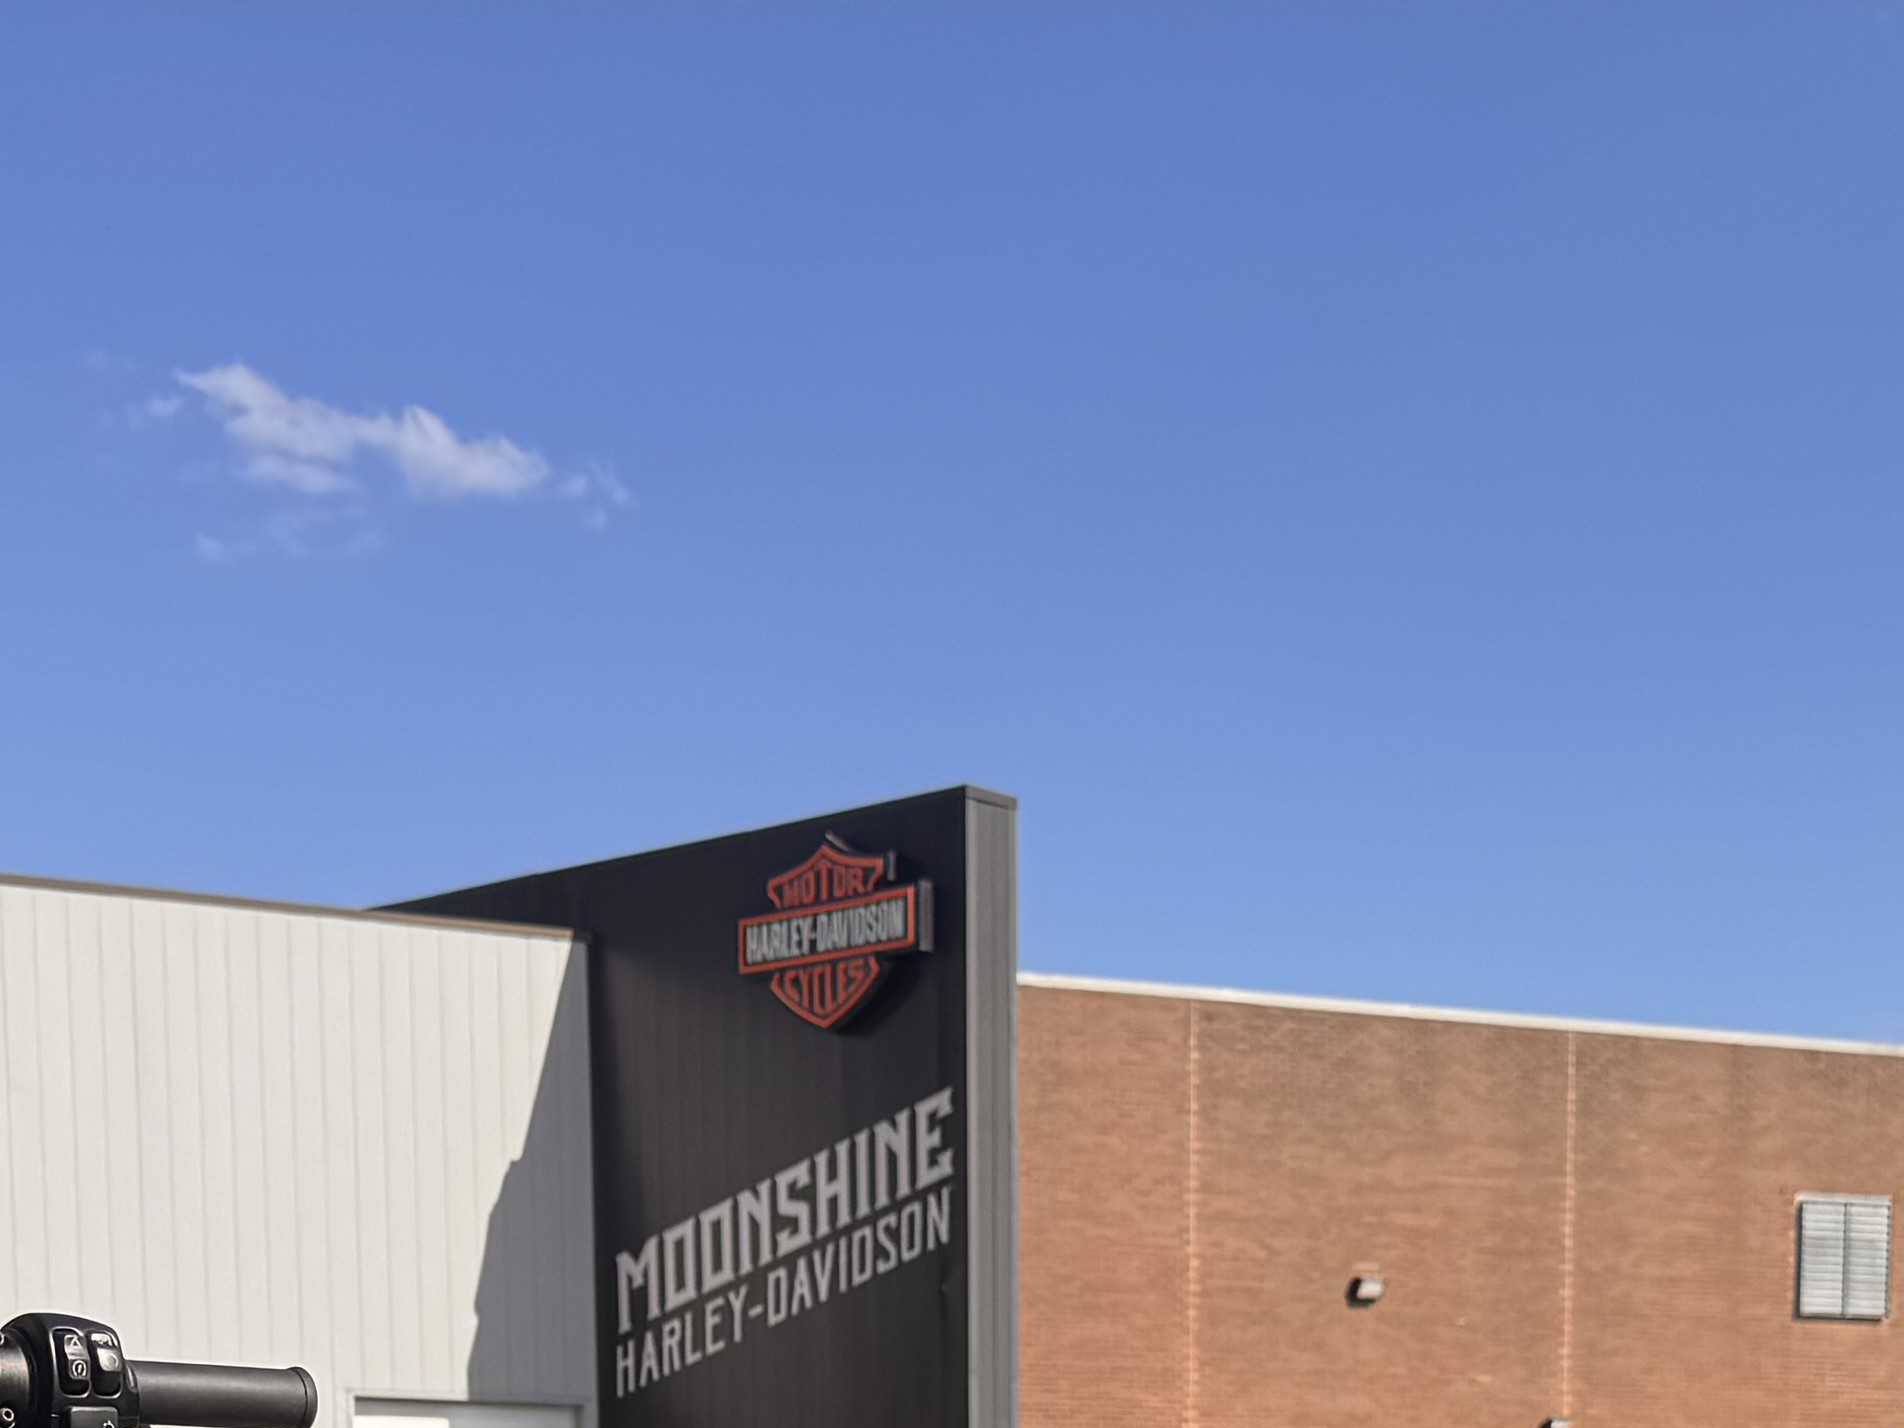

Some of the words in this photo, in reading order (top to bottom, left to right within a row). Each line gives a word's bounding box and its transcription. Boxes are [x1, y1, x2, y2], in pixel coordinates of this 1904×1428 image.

[783, 862, 870, 906] MOTOR
[745, 898, 905, 963] HARLEY-DAVIDSON
[785, 959, 871, 1014] CYCLES
[615, 1088, 954, 1334] MOONSHINE
[616, 1187, 953, 1397] HARLEY-DAVIDSON
